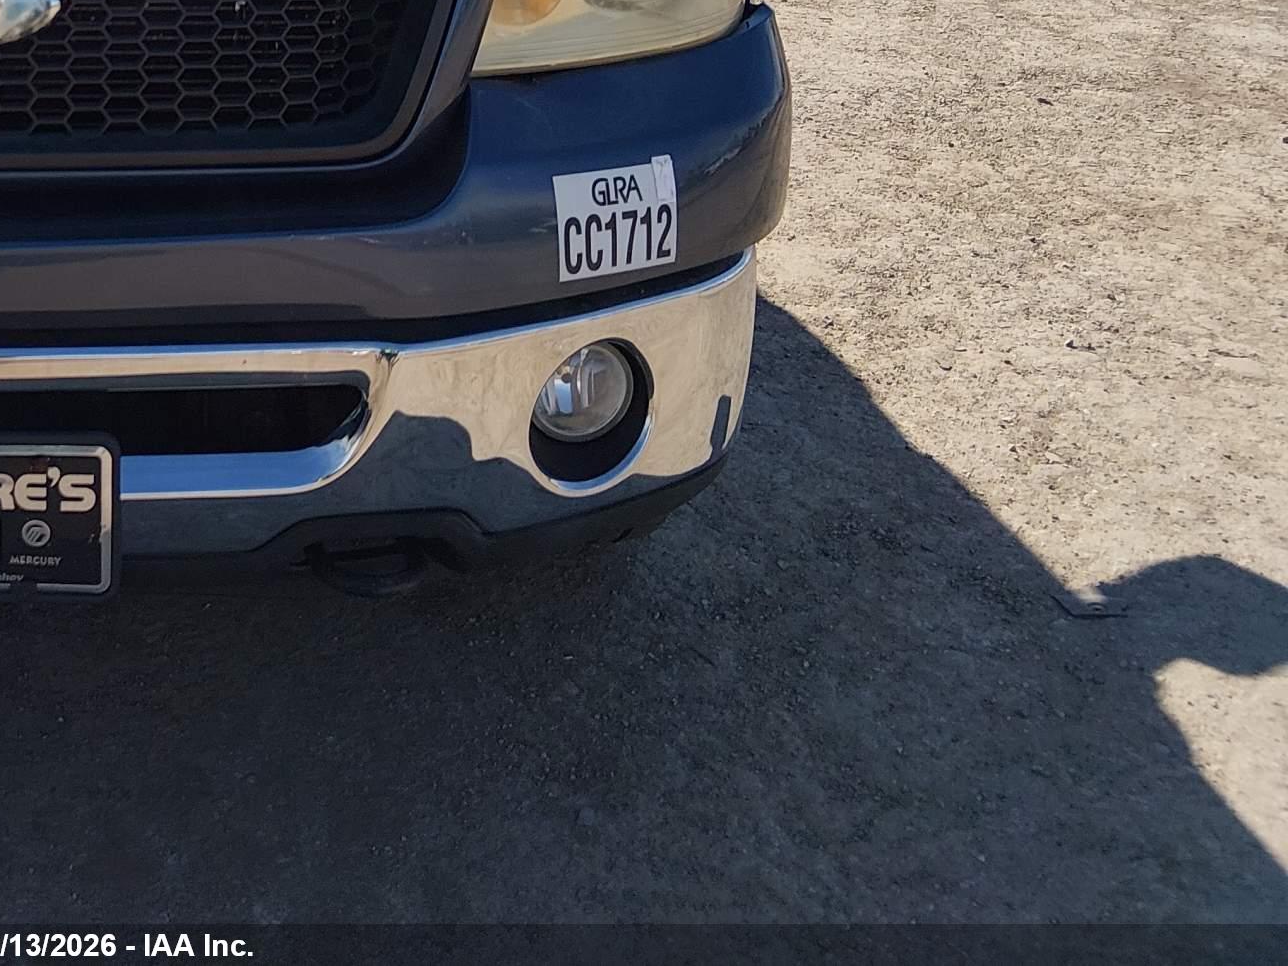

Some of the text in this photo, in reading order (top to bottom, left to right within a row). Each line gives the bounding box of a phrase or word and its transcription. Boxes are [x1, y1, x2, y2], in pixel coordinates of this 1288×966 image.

[591, 174, 643, 207] GLRA
[564, 203, 673, 275] CC1712
[9, 555, 62, 566] MERCURY
